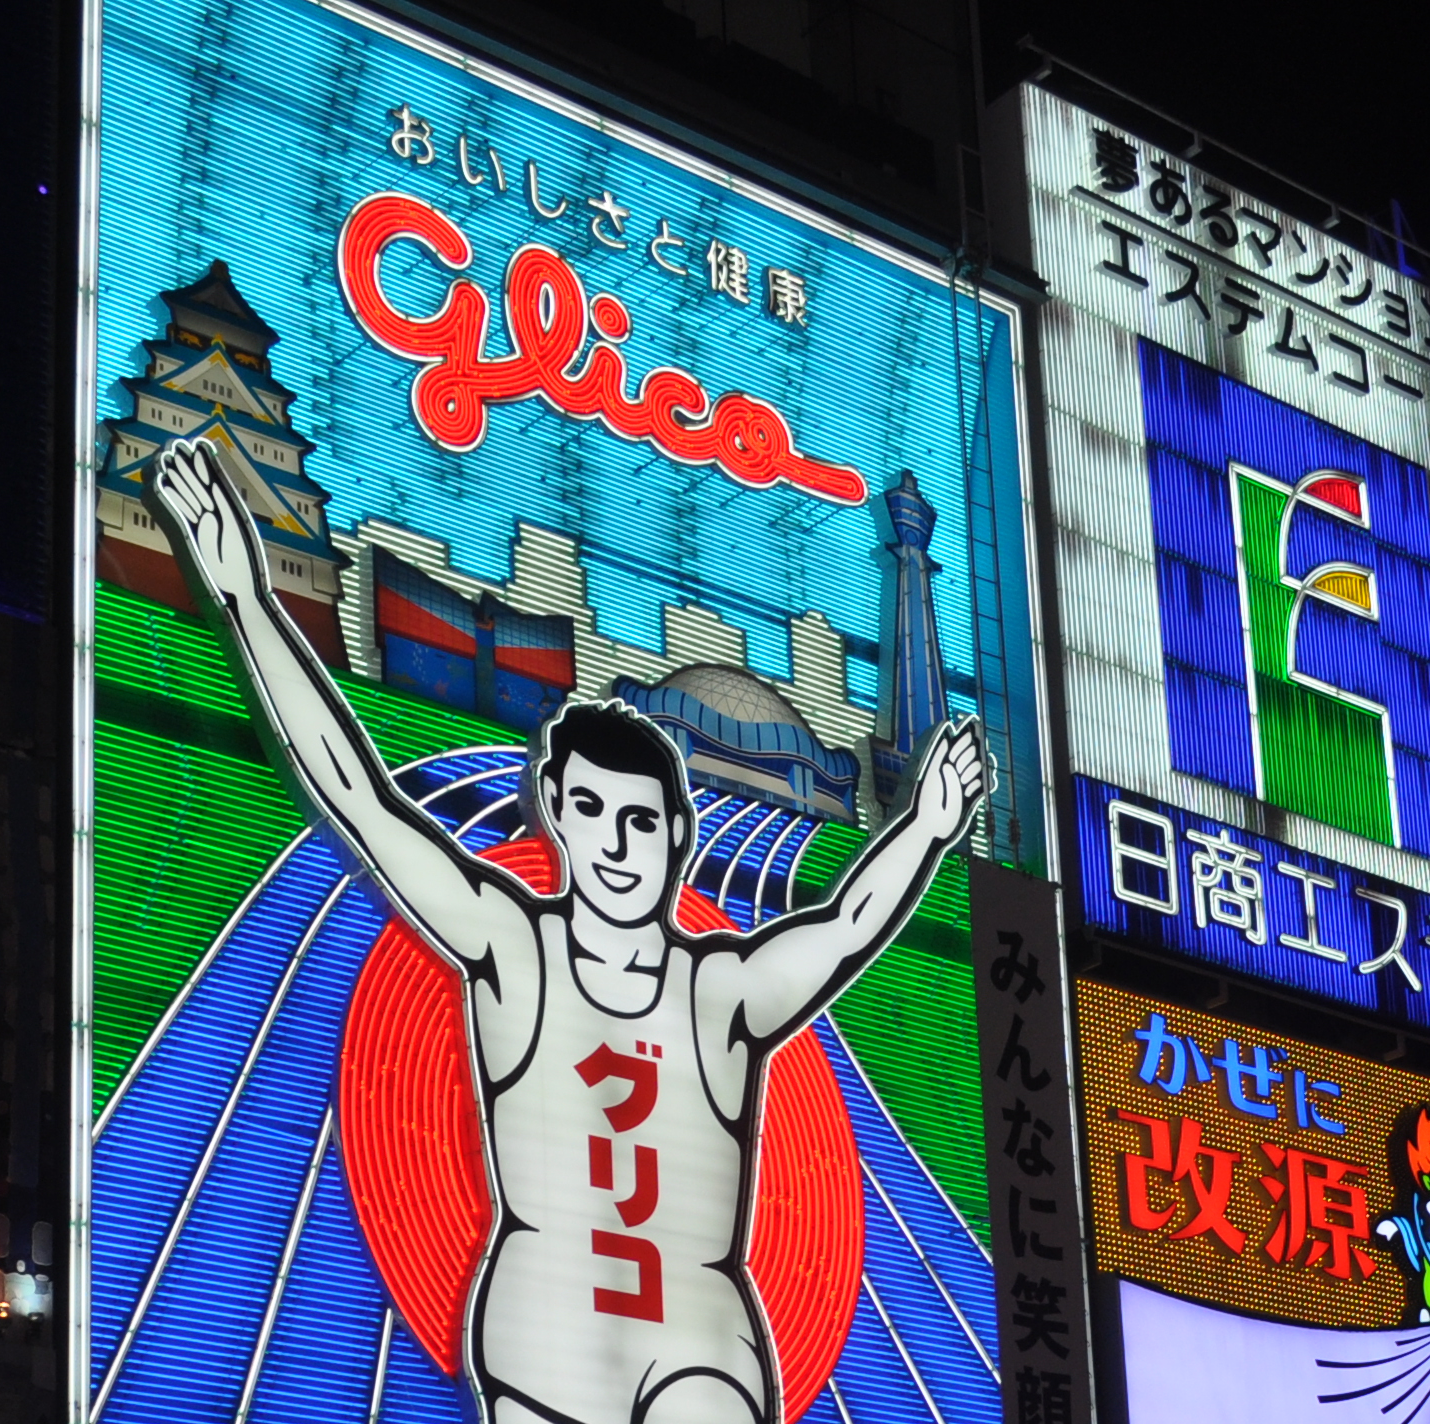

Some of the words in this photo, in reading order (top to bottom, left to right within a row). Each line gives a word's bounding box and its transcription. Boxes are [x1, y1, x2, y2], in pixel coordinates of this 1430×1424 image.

[389, 103, 808, 331] おいしさと健康
[338, 190, 869, 507] Glico
[573, 1040, 664, 1324] グリコ
[1135, 1013, 1346, 1136] かぜに
[1116, 1108, 1377, 1280] 改源
